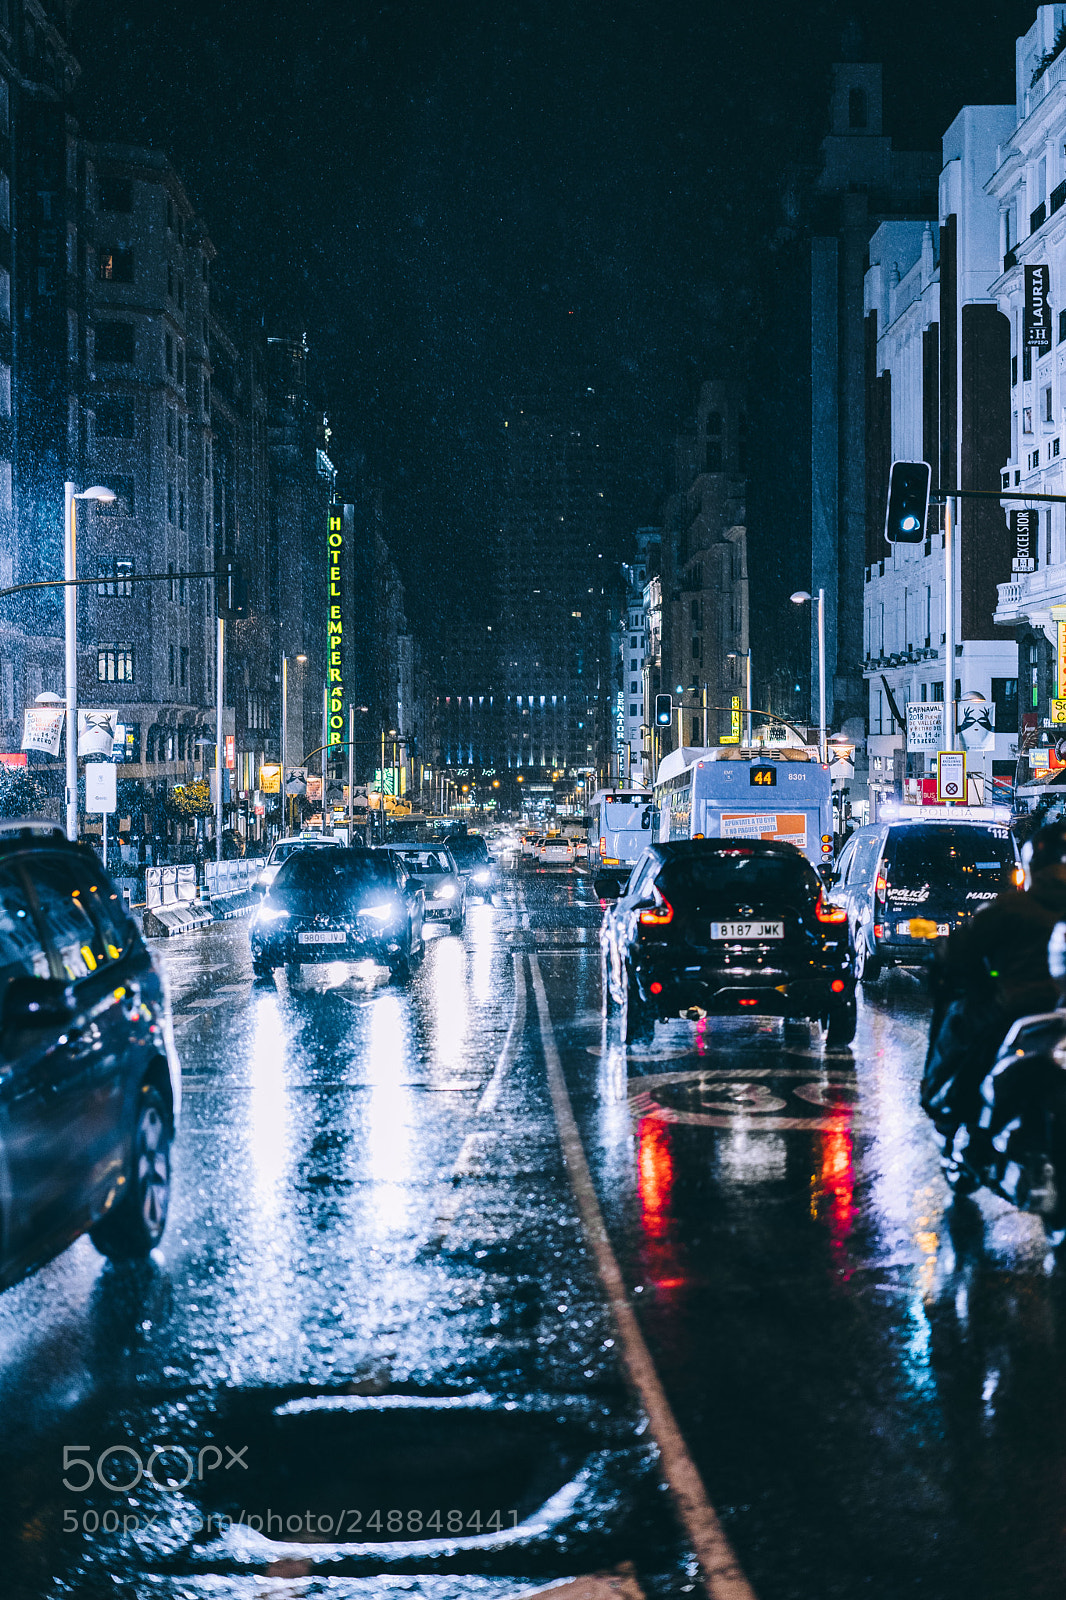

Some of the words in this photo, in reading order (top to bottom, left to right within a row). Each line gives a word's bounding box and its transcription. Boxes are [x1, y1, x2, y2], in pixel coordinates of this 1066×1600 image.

[1033, 267, 1043, 326] LAURIA
[329, 517, 342, 596] HOTEL
[1017, 512, 1029, 558] EXCELSIOR
[329, 605, 343, 745] EMPERADOR
[754, 772, 771, 784] 44
[993, 829, 1009, 839] 112
[721, 925, 751, 936] 8187
[757, 925, 779, 936] JMK
